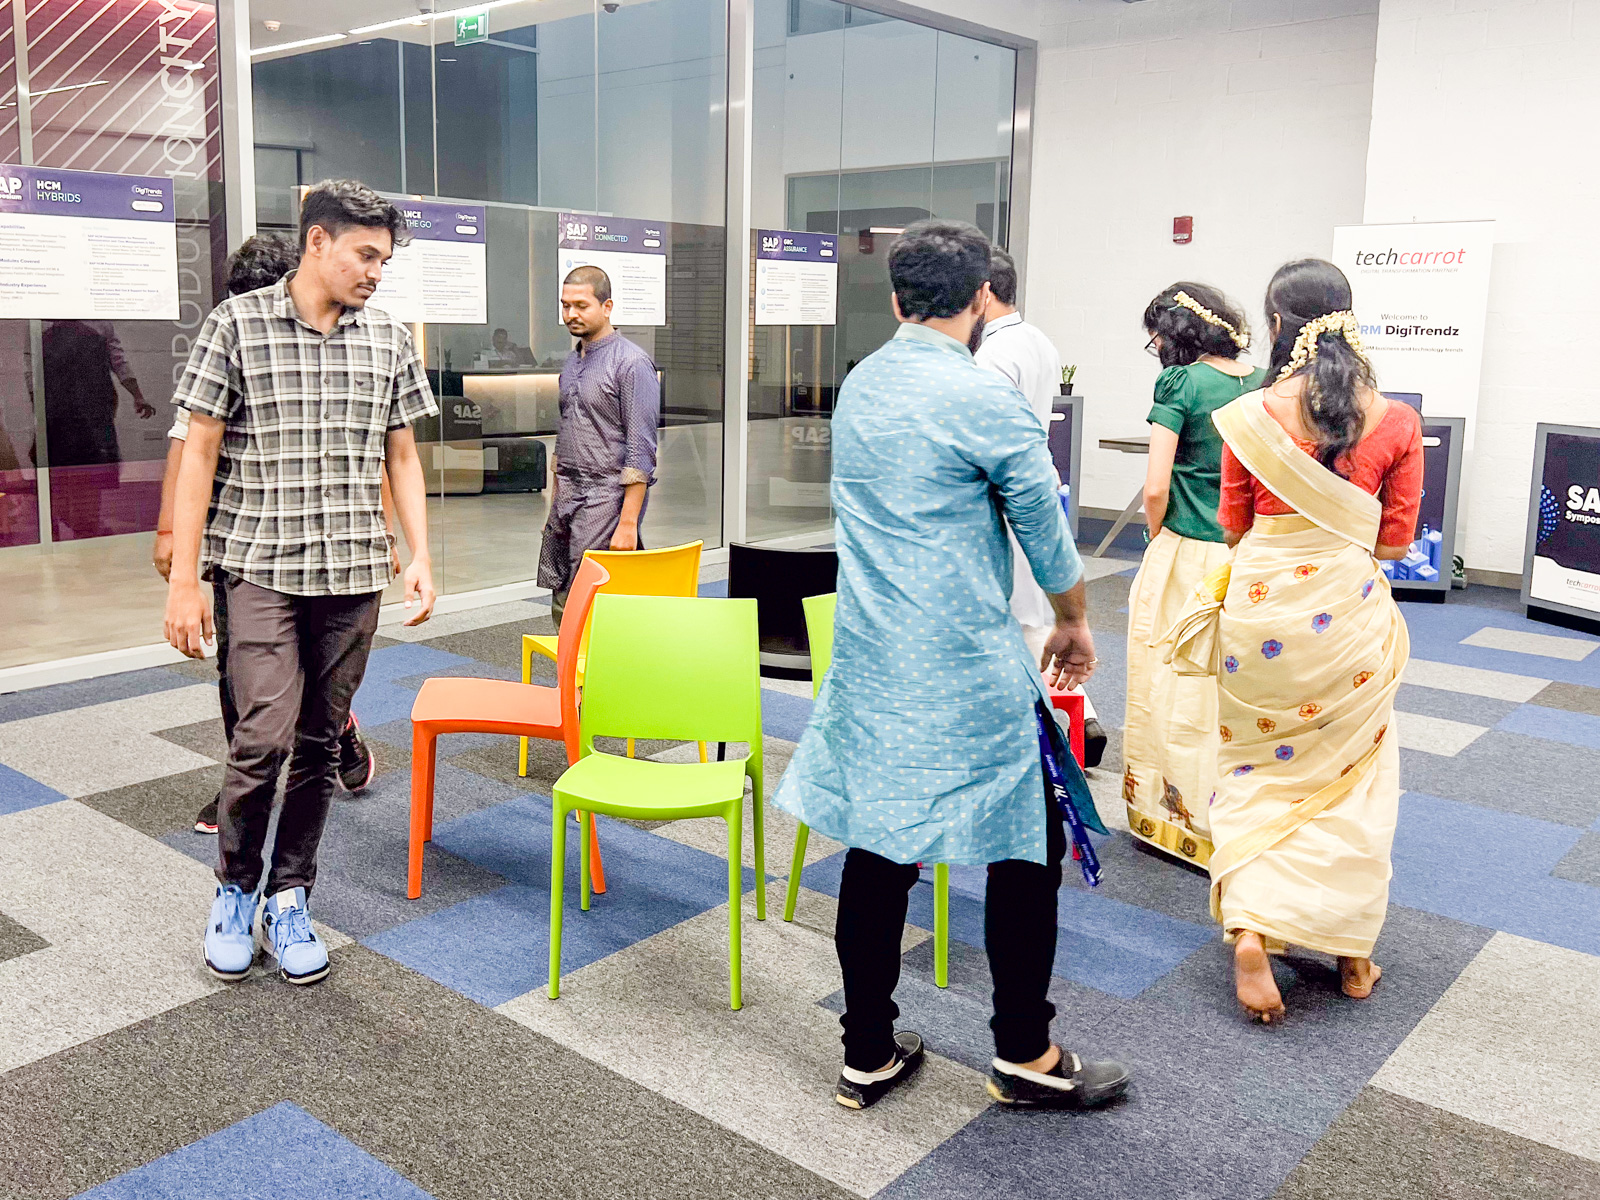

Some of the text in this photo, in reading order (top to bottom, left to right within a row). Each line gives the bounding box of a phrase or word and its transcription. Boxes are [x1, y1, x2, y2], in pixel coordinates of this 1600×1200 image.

[0, 176, 23, 194] AP
[36, 180, 61, 191] HCM
[37, 191, 82, 203] HYBRIDS
[406, 220, 419, 228] THE
[566, 223, 588, 236] SAP
[594, 234, 628, 243] CONNECTED
[762, 237, 779, 248] SAP
[1355, 248, 1466, 266] techcarrot
[1380, 313, 1428, 321] Welcome to
[1358, 325, 1459, 338] RM DigiTrendz
[1565, 484, 1600, 513] SA
[1565, 510, 1600, 525] Sympos
[1566, 578, 1600, 590] techcarro
